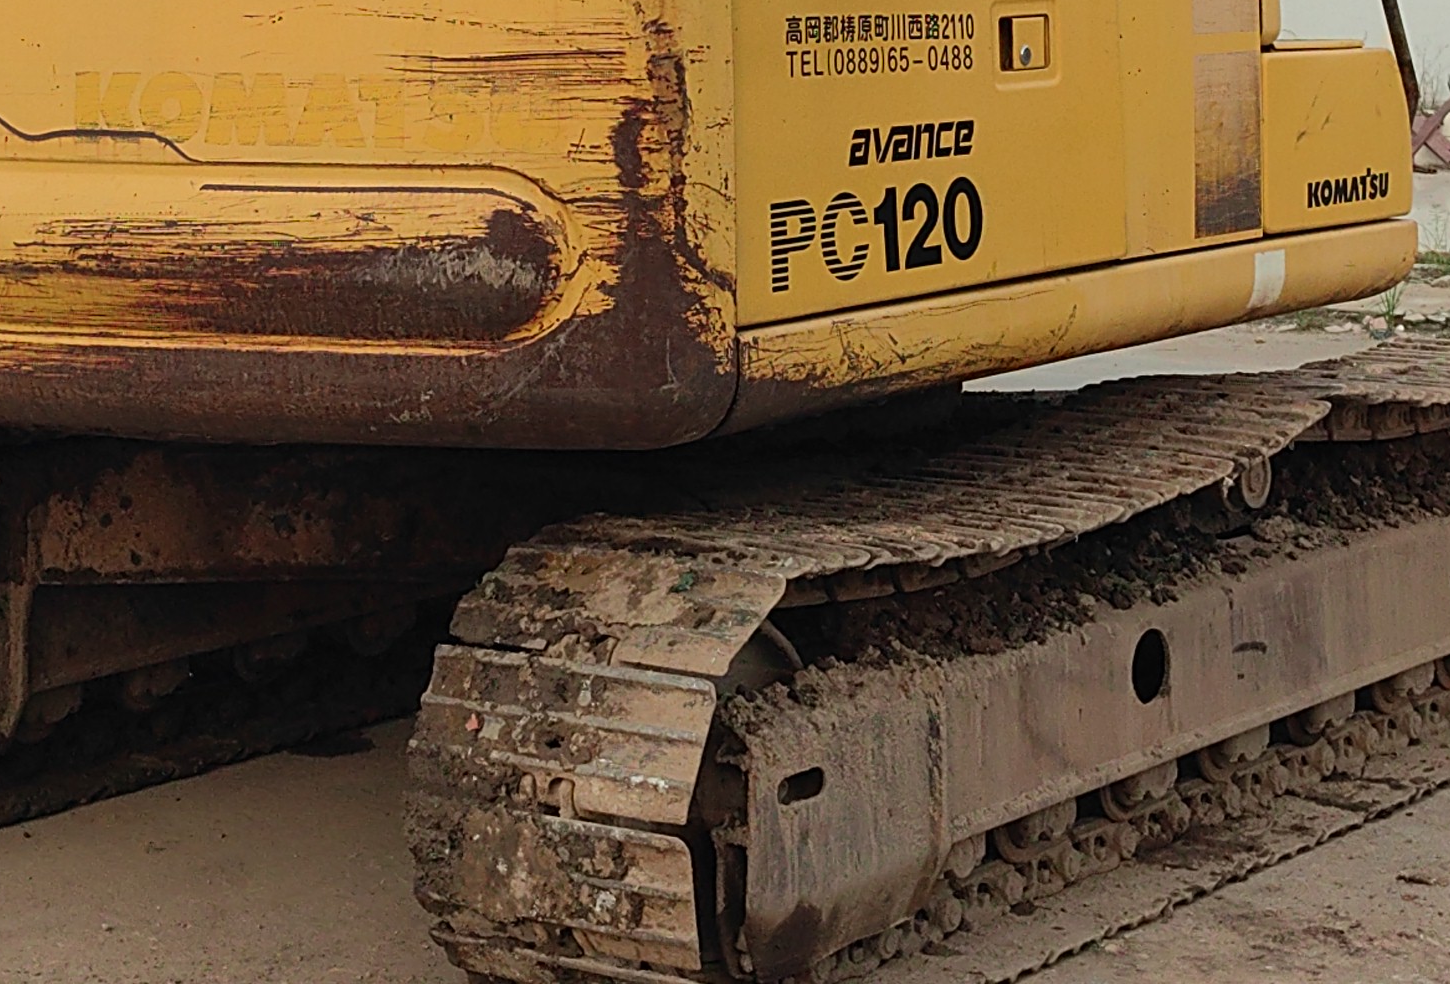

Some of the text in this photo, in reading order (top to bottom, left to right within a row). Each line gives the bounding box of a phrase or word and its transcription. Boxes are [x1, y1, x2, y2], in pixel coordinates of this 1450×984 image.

[848, 119, 975, 167] avance
[1307, 167, 1389, 208] KOMATSU
[769, 176, 983, 293] PC120
